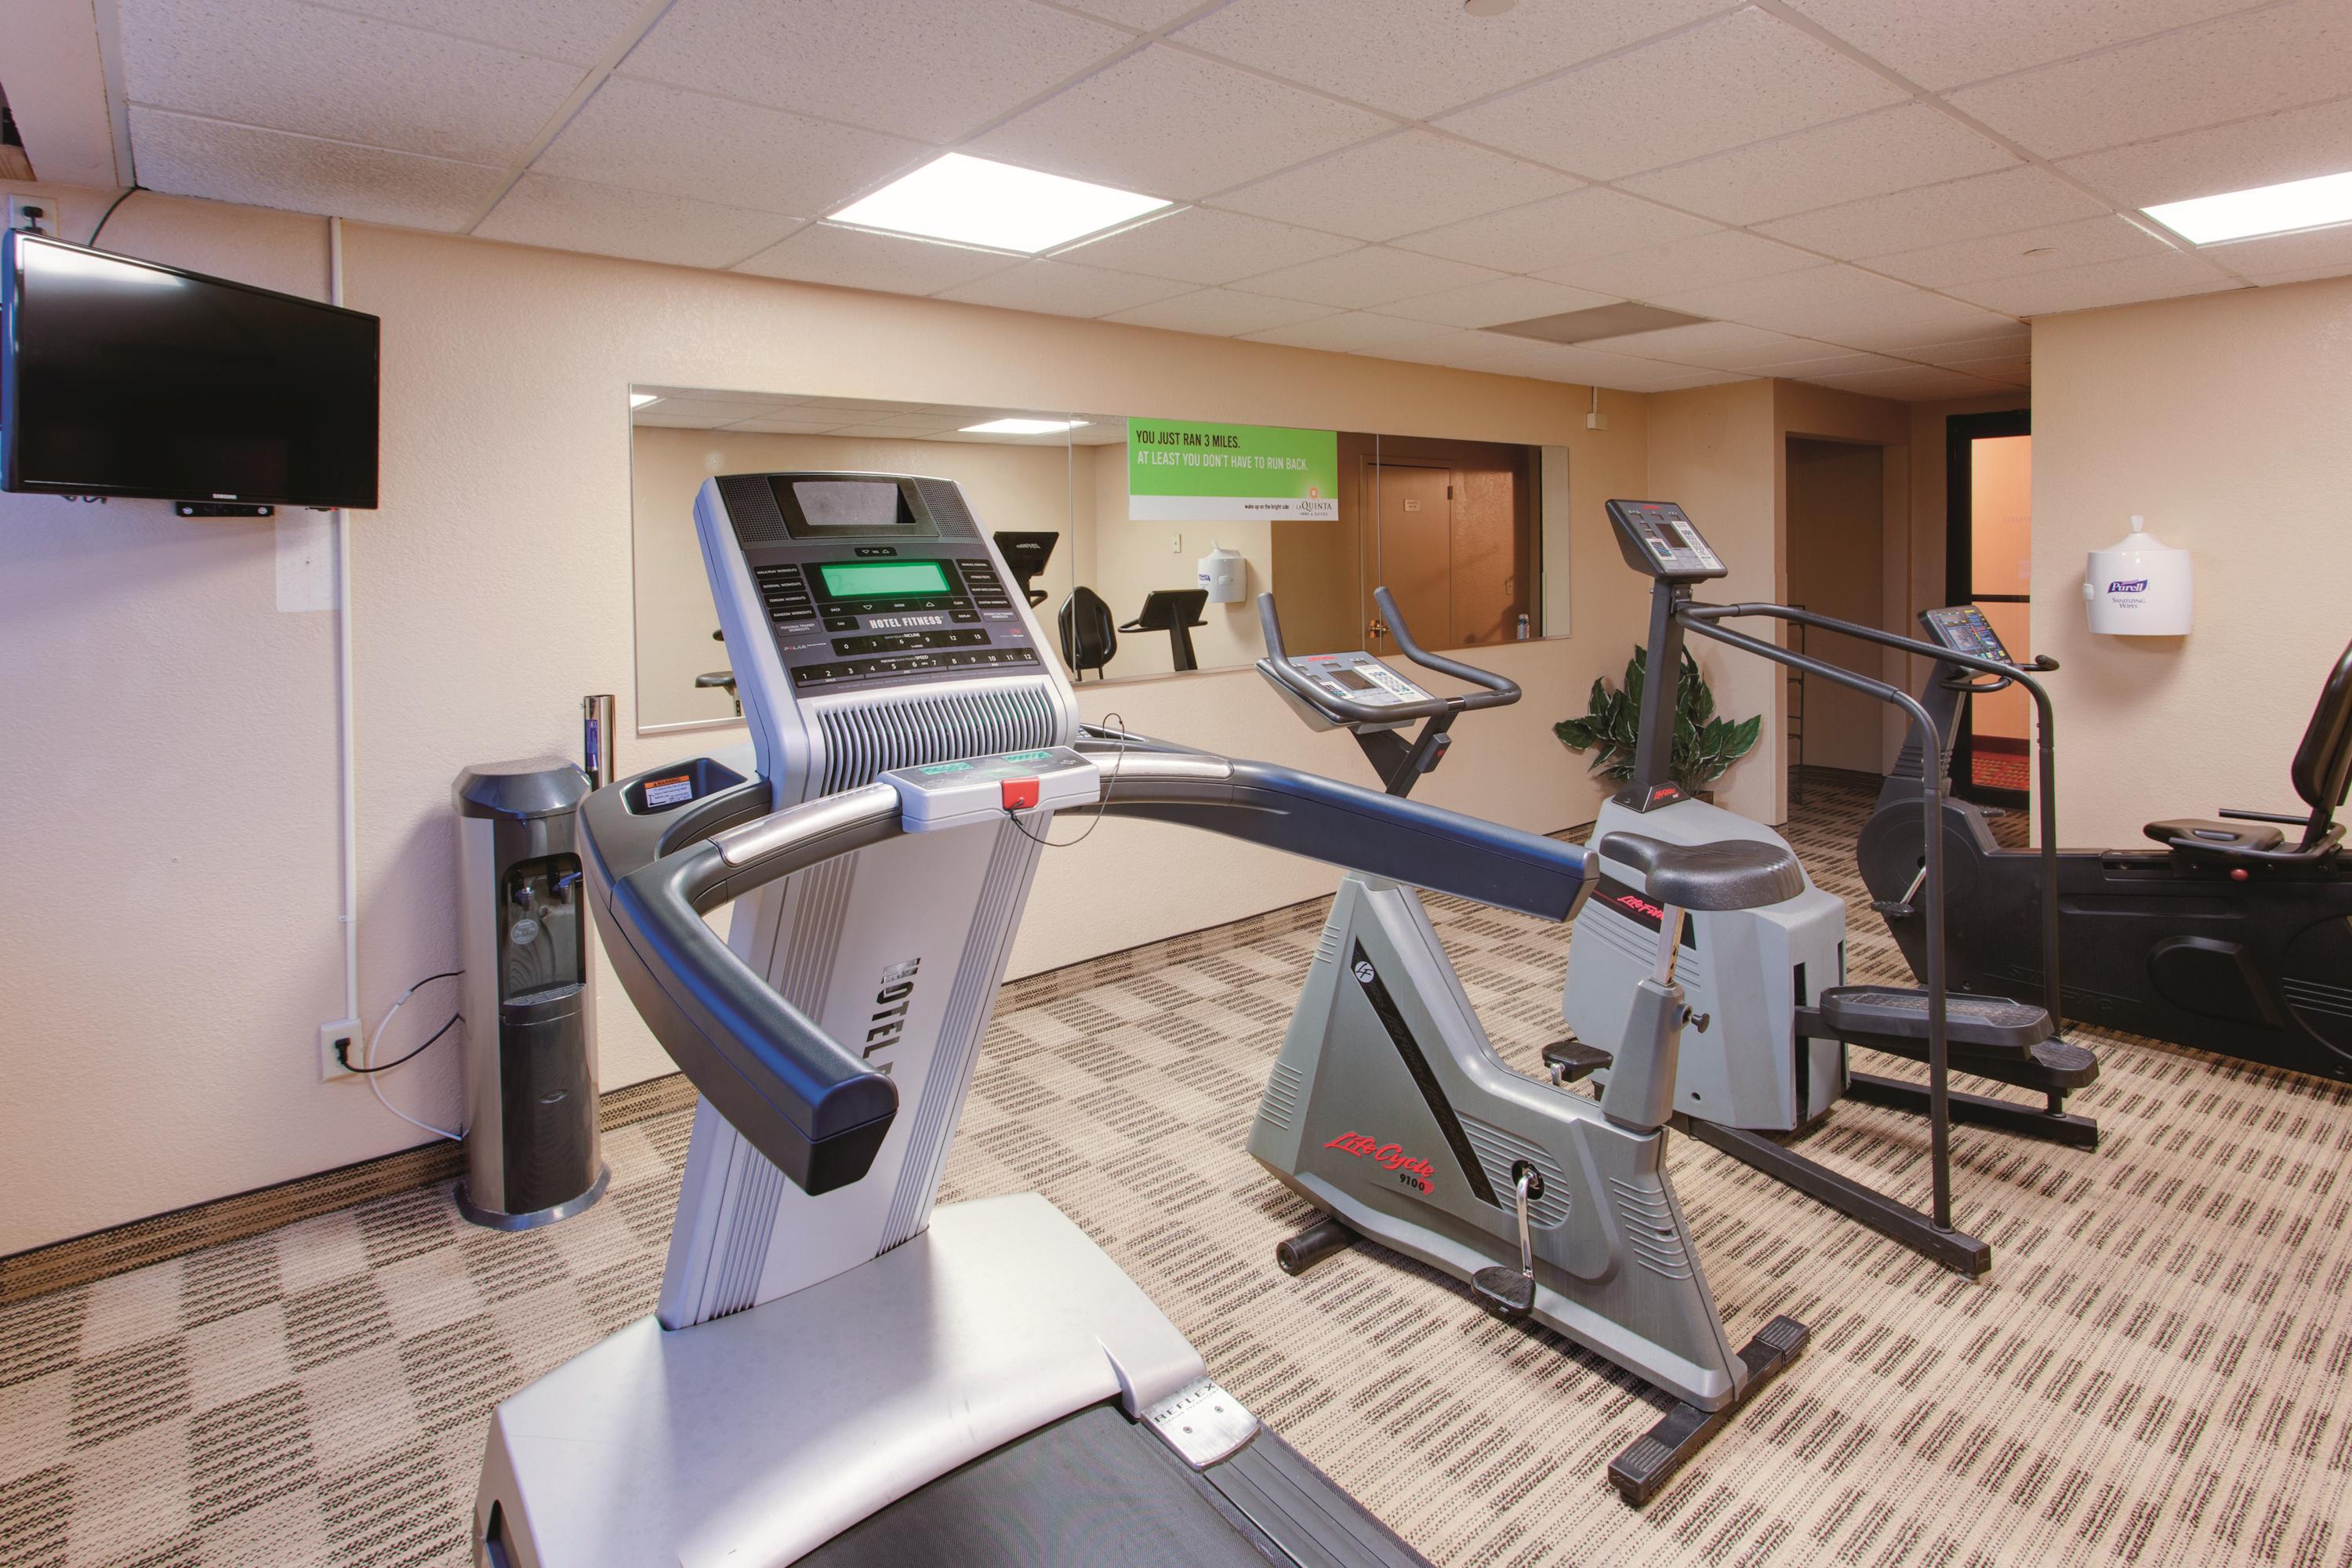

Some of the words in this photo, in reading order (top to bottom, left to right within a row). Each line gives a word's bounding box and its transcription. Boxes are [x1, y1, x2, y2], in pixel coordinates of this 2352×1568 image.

[1136, 430, 1155, 444] YOU
[1158, 431, 1180, 445] JUST
[1183, 433, 1201, 446] RAN
[1204, 434, 1210, 447] 3
[1212, 434, 1240, 448] MILES.
[1138, 451, 1149, 464] AT
[1152, 452, 1180, 466] LEAST
[1182, 452, 1200, 466] YOU
[1203, 453, 1229, 467] DON'T
[1231, 455, 1252, 468] HAVE
[1254, 456, 1265, 469] TO
[1267, 457, 1283, 470] RUN
[1286, 458, 1308, 471] BACK.
[2111, 583, 2144, 591] Purell
[869, 618, 902, 629] HOTEL
[902, 615, 942, 626] FITNESS
[862, 957, 921, 1059] HOTEL
[1399, 1173, 1425, 1192] 9100
[1154, 1383, 1215, 1422] REFLEX
